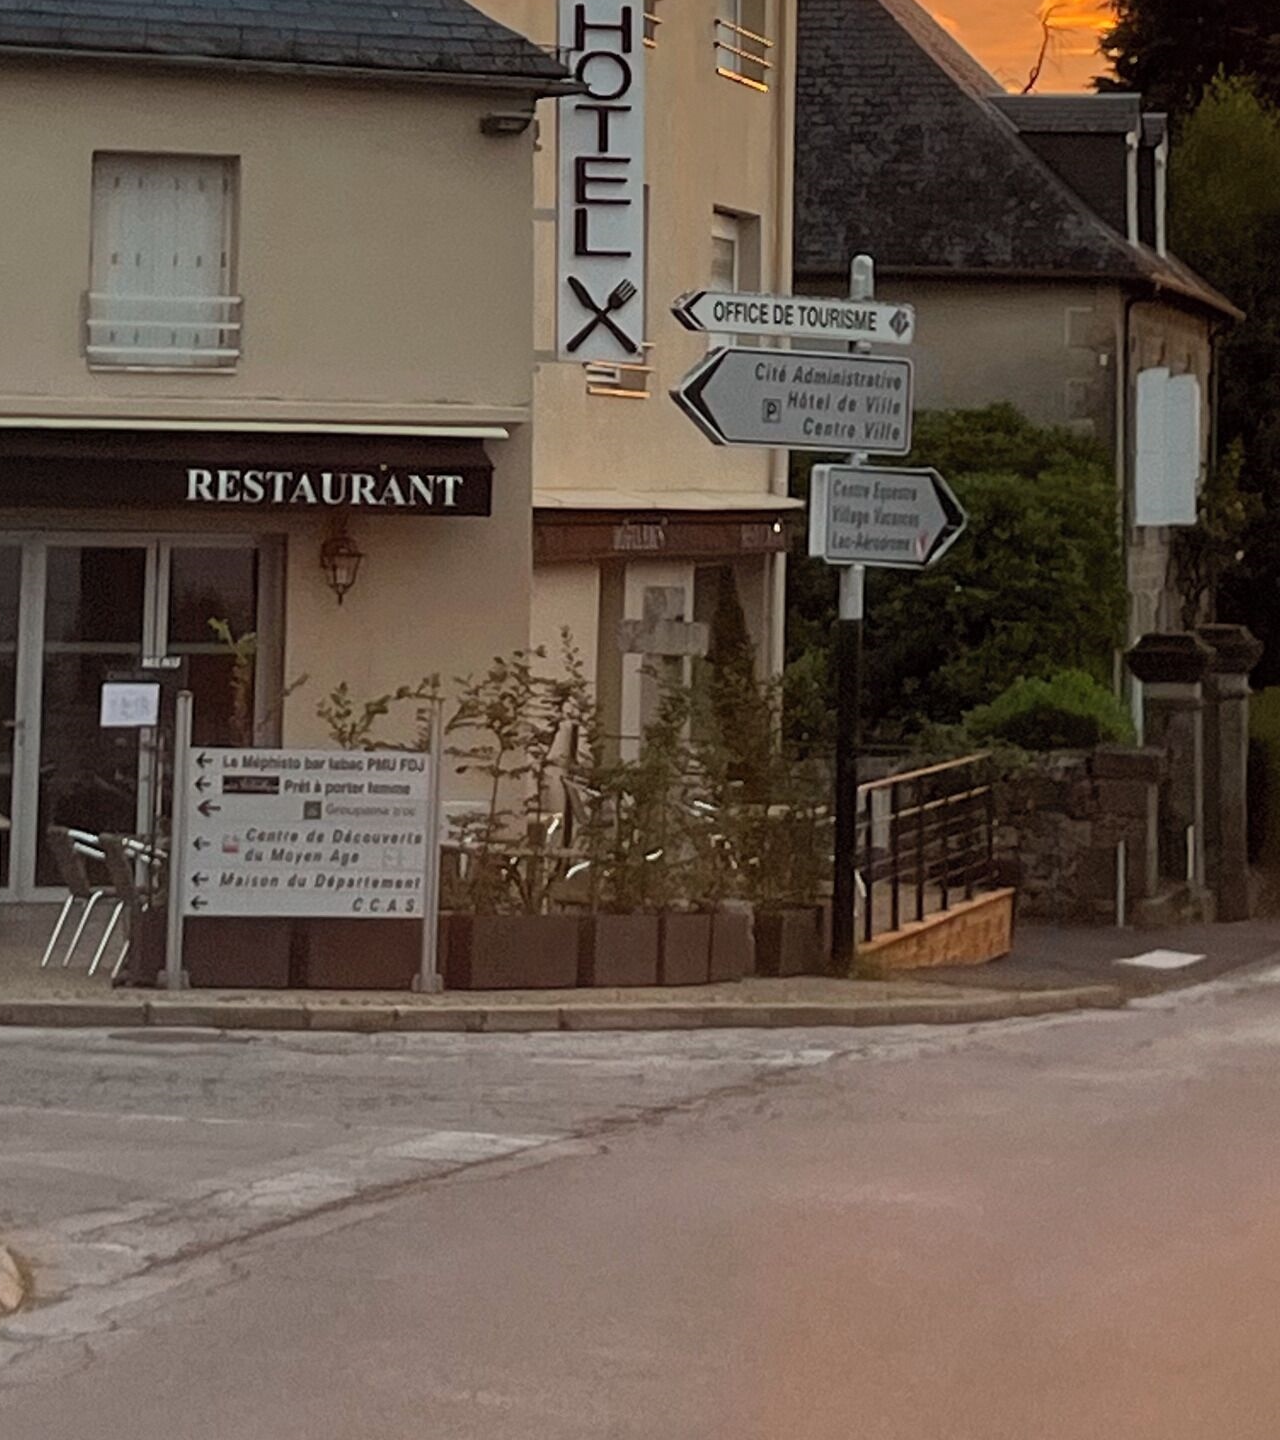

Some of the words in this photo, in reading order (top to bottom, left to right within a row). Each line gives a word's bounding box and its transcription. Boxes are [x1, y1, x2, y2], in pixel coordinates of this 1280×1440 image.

[574, 4, 633, 259] HOTEL
[712, 300, 769, 324] OFFICE
[773, 304, 794, 325] DE
[797, 306, 878, 332] TOURISME
[754, 362, 787, 383] Cité
[792, 366, 902, 391] Administrative
[787, 390, 831, 410] Hôtel
[837, 394, 857, 412] de
[866, 396, 901, 415] Ville
[802, 416, 856, 438] Centre
[865, 422, 901, 441] Ville
[186, 468, 463, 506] RESTAURANT
[222, 755, 238, 769] Le
[245, 827, 298, 843] Centre
[306, 829, 324, 843] de
[332, 829, 423, 845] Découverte
[244, 847, 263, 862] du
[270, 848, 322, 865] Moyen
[219, 871, 279, 888] Maison
[287, 873, 307, 888] du
[314, 873, 421, 891] Département
